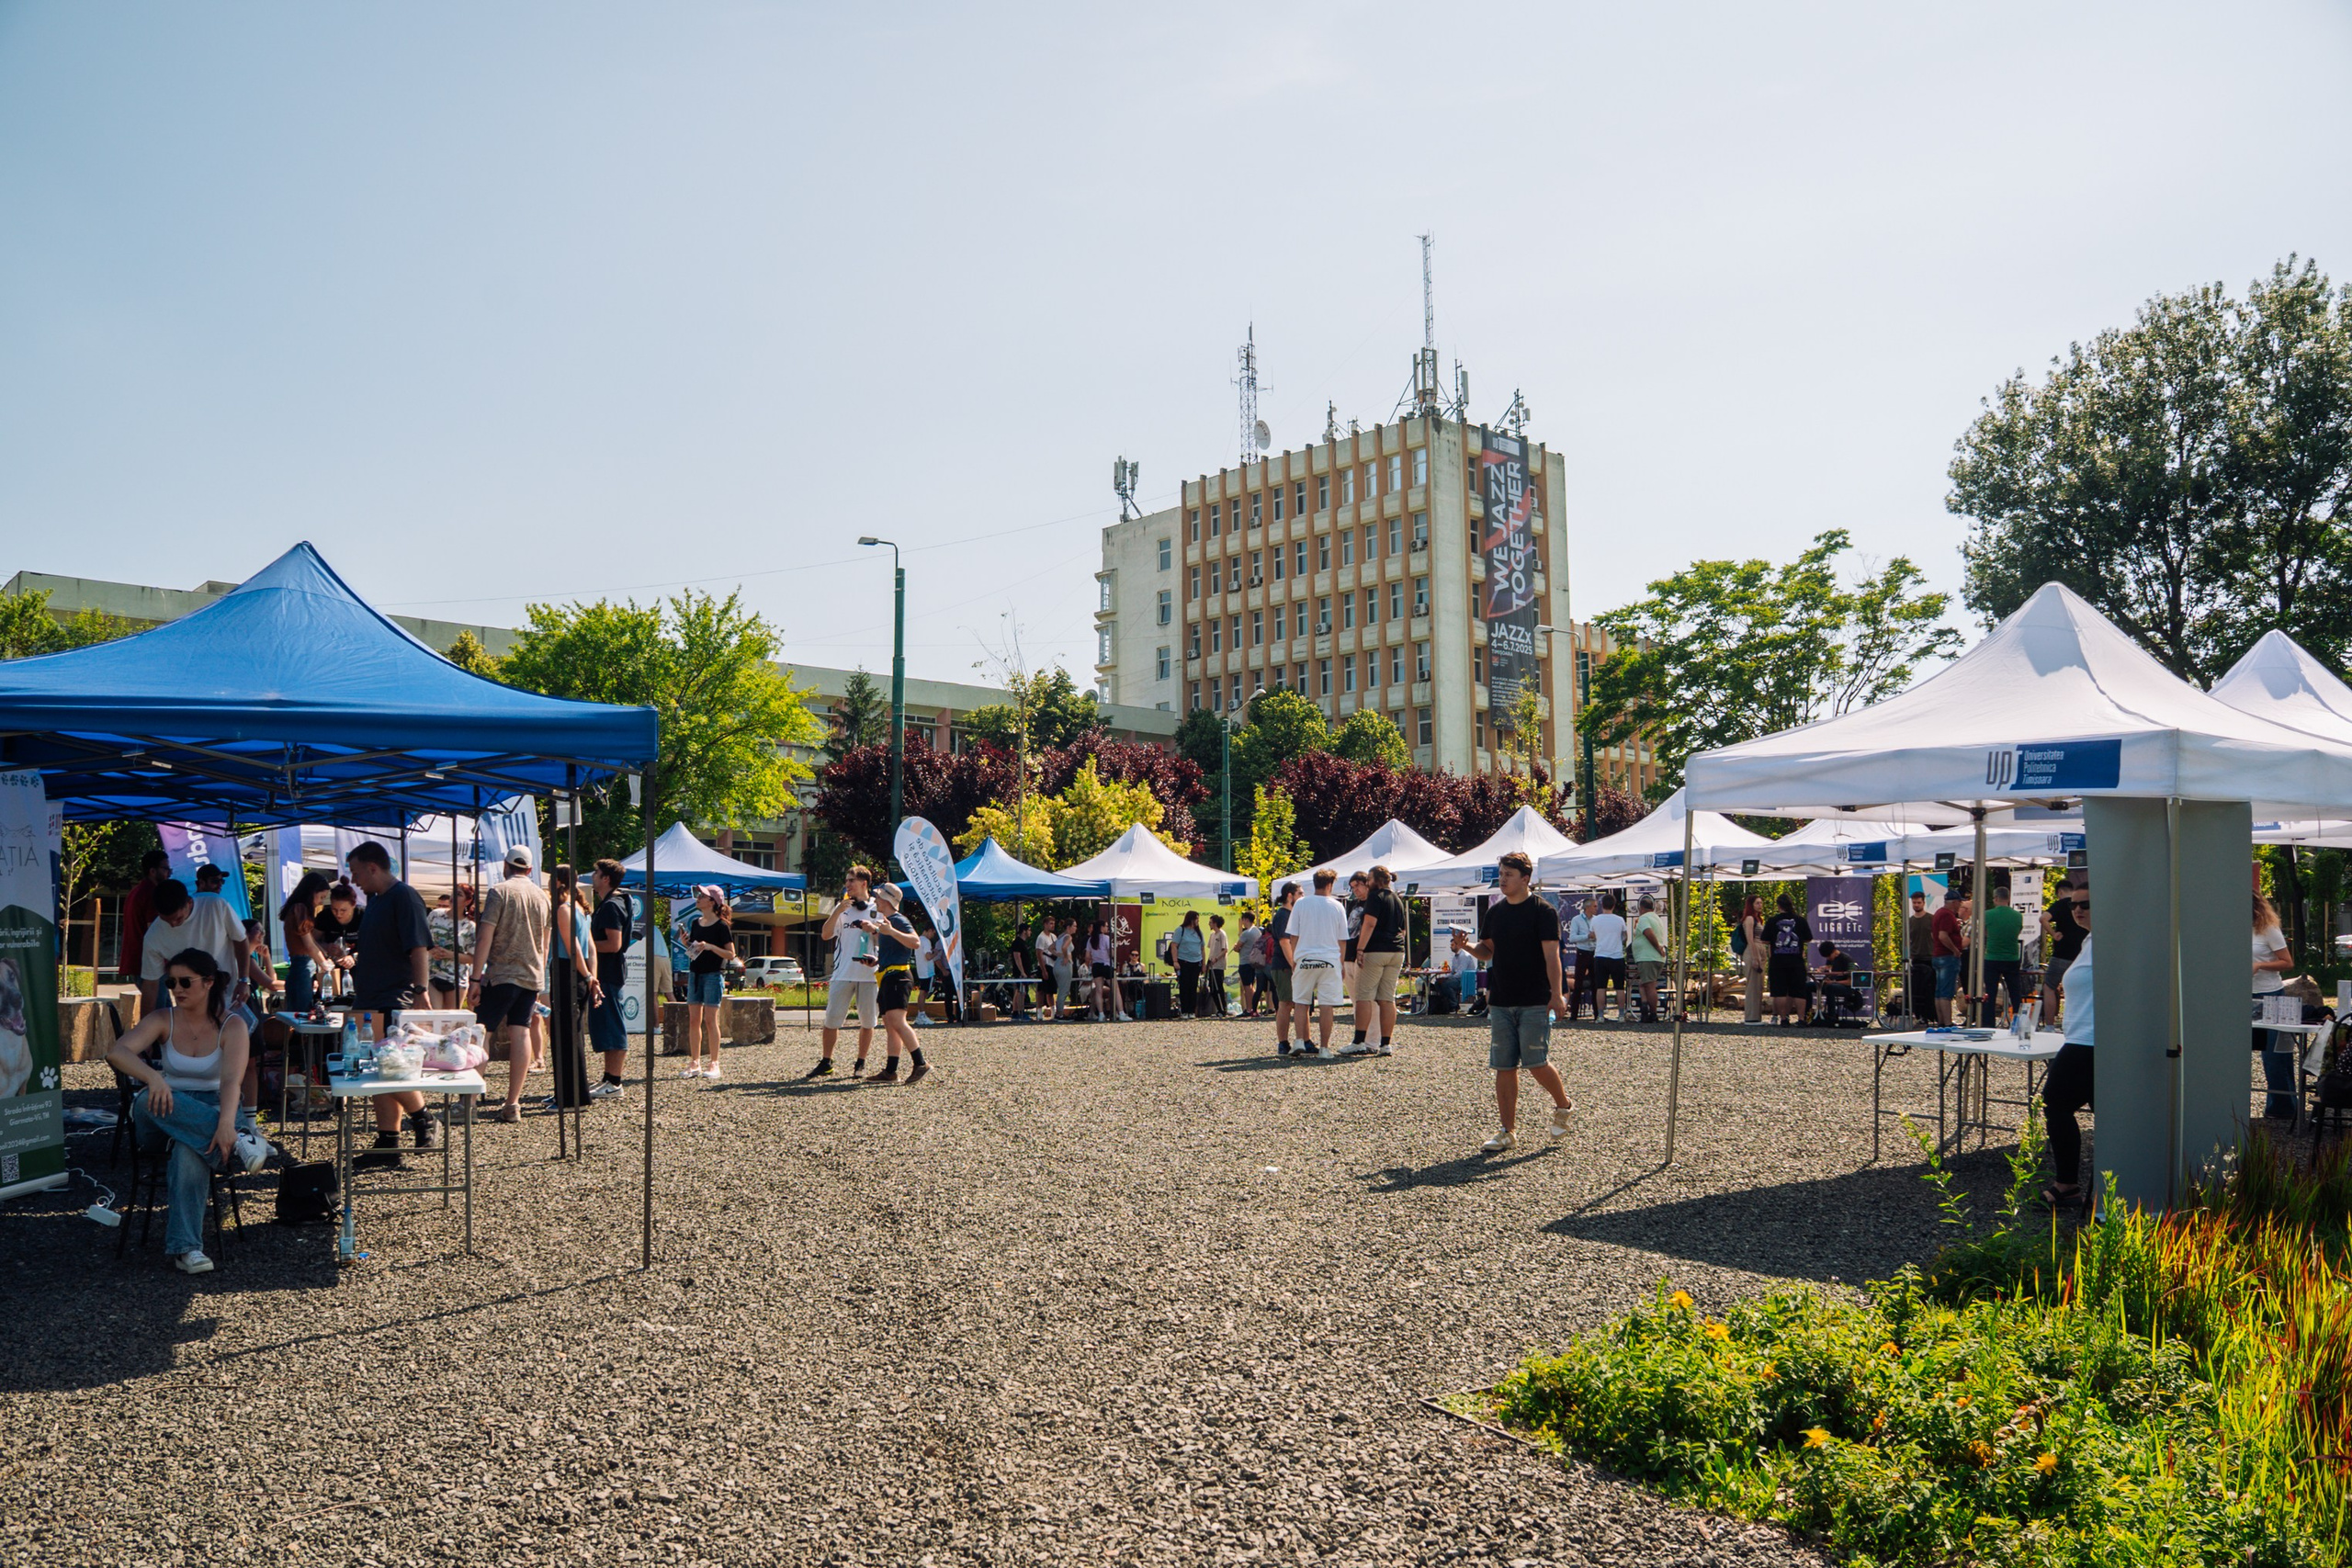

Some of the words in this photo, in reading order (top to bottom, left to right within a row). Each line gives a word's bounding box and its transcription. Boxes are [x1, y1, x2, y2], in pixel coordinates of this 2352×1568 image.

[1490, 464, 1507, 539] JAZZ
[1507, 461, 1526, 611] TOGETHER
[1492, 546, 1510, 592] WE
[2024, 750, 2064, 761] Universitatea
[2023, 761, 2057, 773] Politehnica
[2022, 774, 2052, 786] Timișoara
[1161, 899, 1192, 908] NOKIA
[1819, 922, 1843, 933] LIGA
